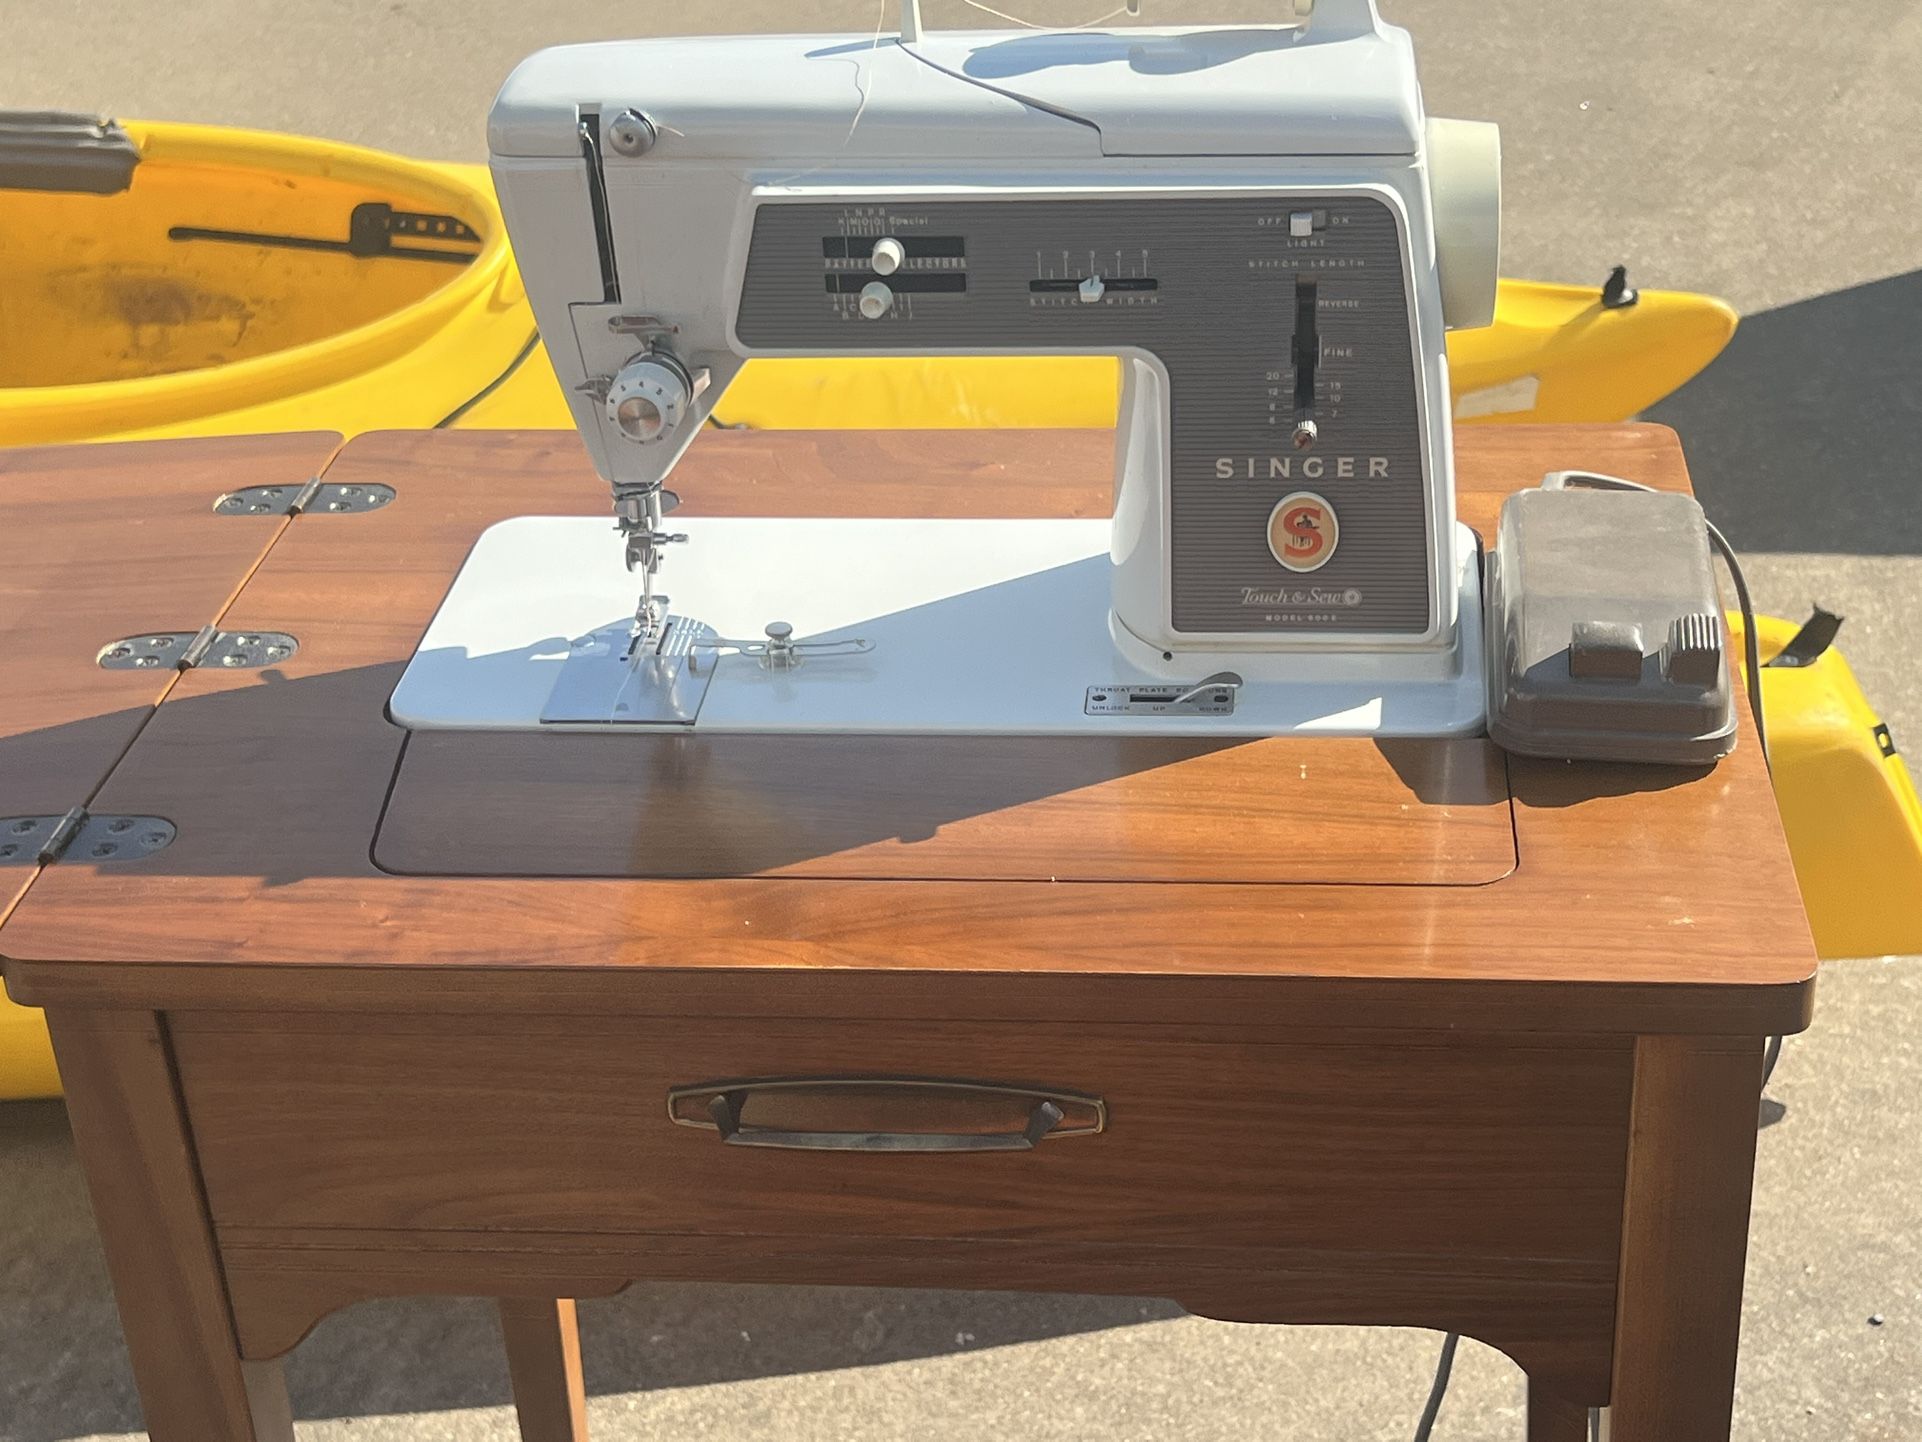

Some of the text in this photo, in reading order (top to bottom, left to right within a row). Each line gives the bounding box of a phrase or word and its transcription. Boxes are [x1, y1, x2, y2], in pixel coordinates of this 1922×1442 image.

[1257, 217, 1282, 226] OFF
[1332, 216, 1349, 225] ON
[1287, 239, 1325, 248] LIGHT
[825, 258, 873, 269] PATTER
[1248, 259, 1365, 268] STITCH LENGTH
[1029, 296, 1158, 306] STITC WIDTH
[1318, 300, 1360, 308] REVERSE
[1323, 348, 1353, 357] FINE
[1265, 371, 1280, 381] 20
[1215, 456, 1389, 479] SINGER
[1283, 507, 1324, 558] S
[1241, 586, 1342, 605] Touch & Sew
[1265, 613, 1302, 622] MODEL
